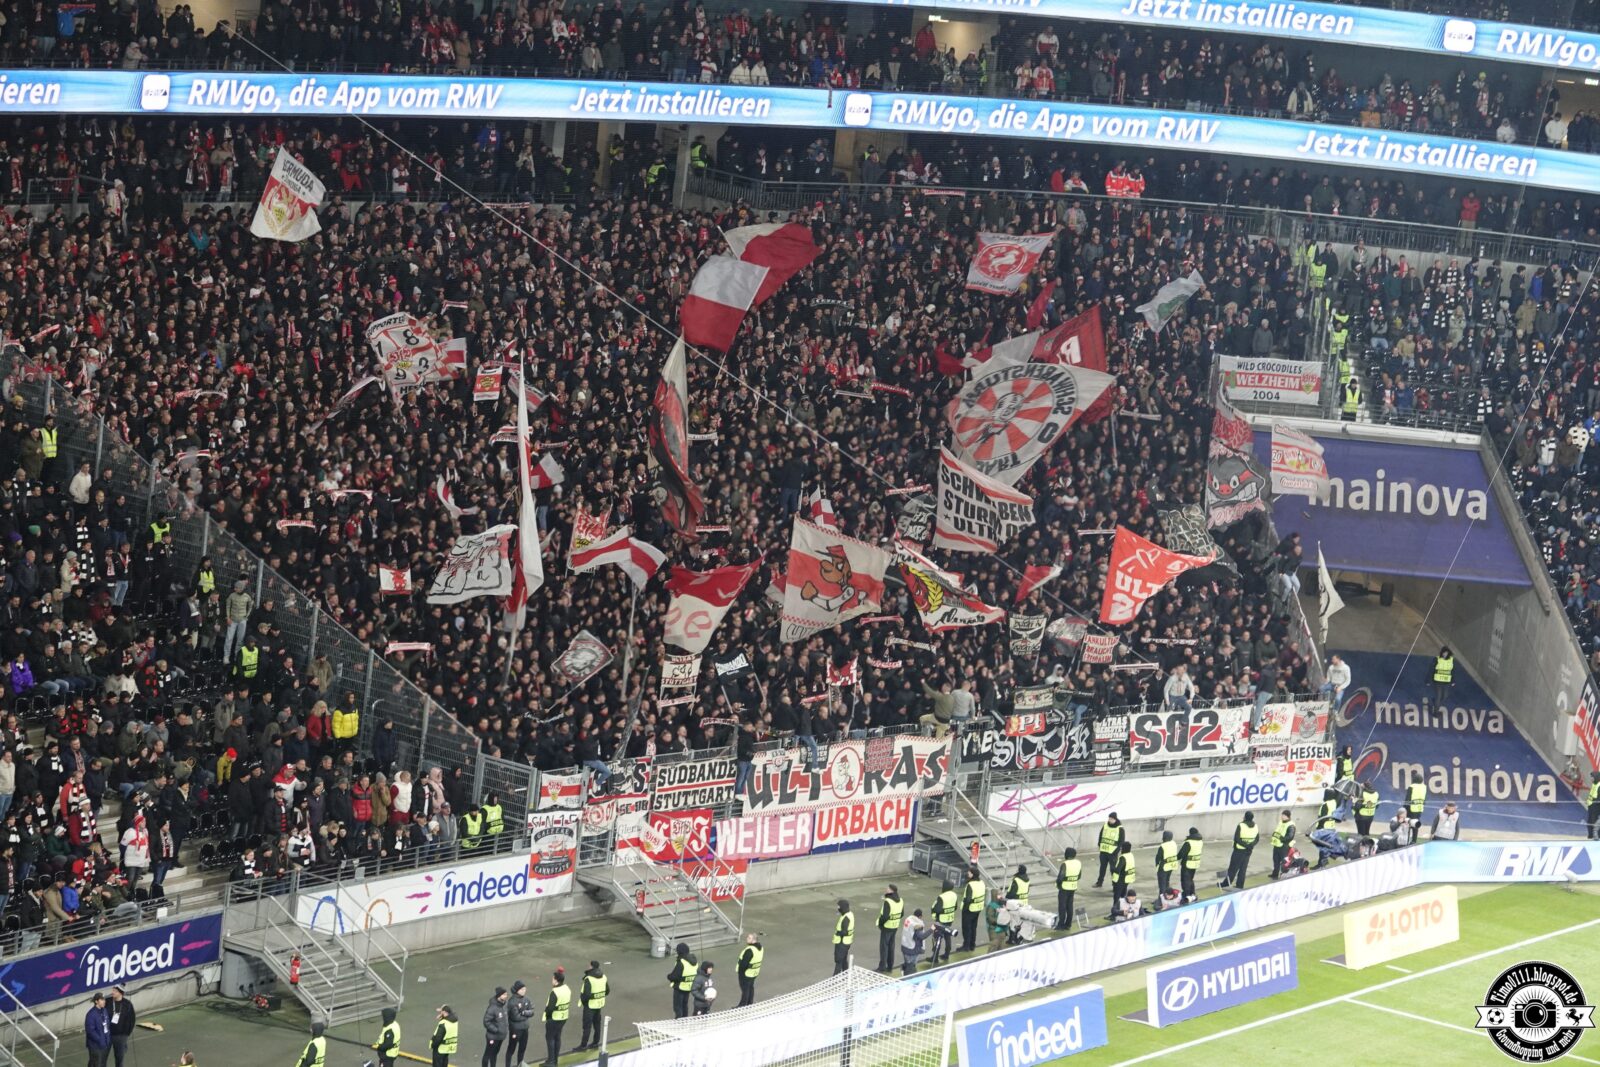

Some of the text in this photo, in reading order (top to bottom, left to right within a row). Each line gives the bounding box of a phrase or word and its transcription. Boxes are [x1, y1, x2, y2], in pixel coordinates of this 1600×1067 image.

[1121, 0, 1355, 35] Jetzt installieren
[188, 79, 504, 113] RMVgo, die App vom RMV
[569, 86, 771, 118] Jetzt installieren
[889, 99, 1221, 143] RMVgo, die App vom RMV
[1297, 130, 1538, 177] Jetzt installieren
[1236, 374, 1300, 389] WELZHEIM
[1237, 361, 1302, 374] WILD CROCODILES
[1253, 390, 1280, 400] 2004
[1375, 697, 1504, 733] mainova
[1290, 746, 1332, 759] HESSEN
[657, 760, 736, 787] SÜDBANDE
[746, 745, 947, 810] ULTRAS
[1391, 757, 1557, 803] mainova
[653, 786, 734, 811] STUTTGART
[716, 814, 811, 857] WEILER
[816, 798, 911, 841] URBACH
[440, 864, 529, 908] indeed
[1390, 899, 1443, 936] LOTTO
[80, 932, 175, 986] indeed
[1203, 952, 1290, 998] HYUNDAI
[987, 1005, 1082, 1067] indeed
